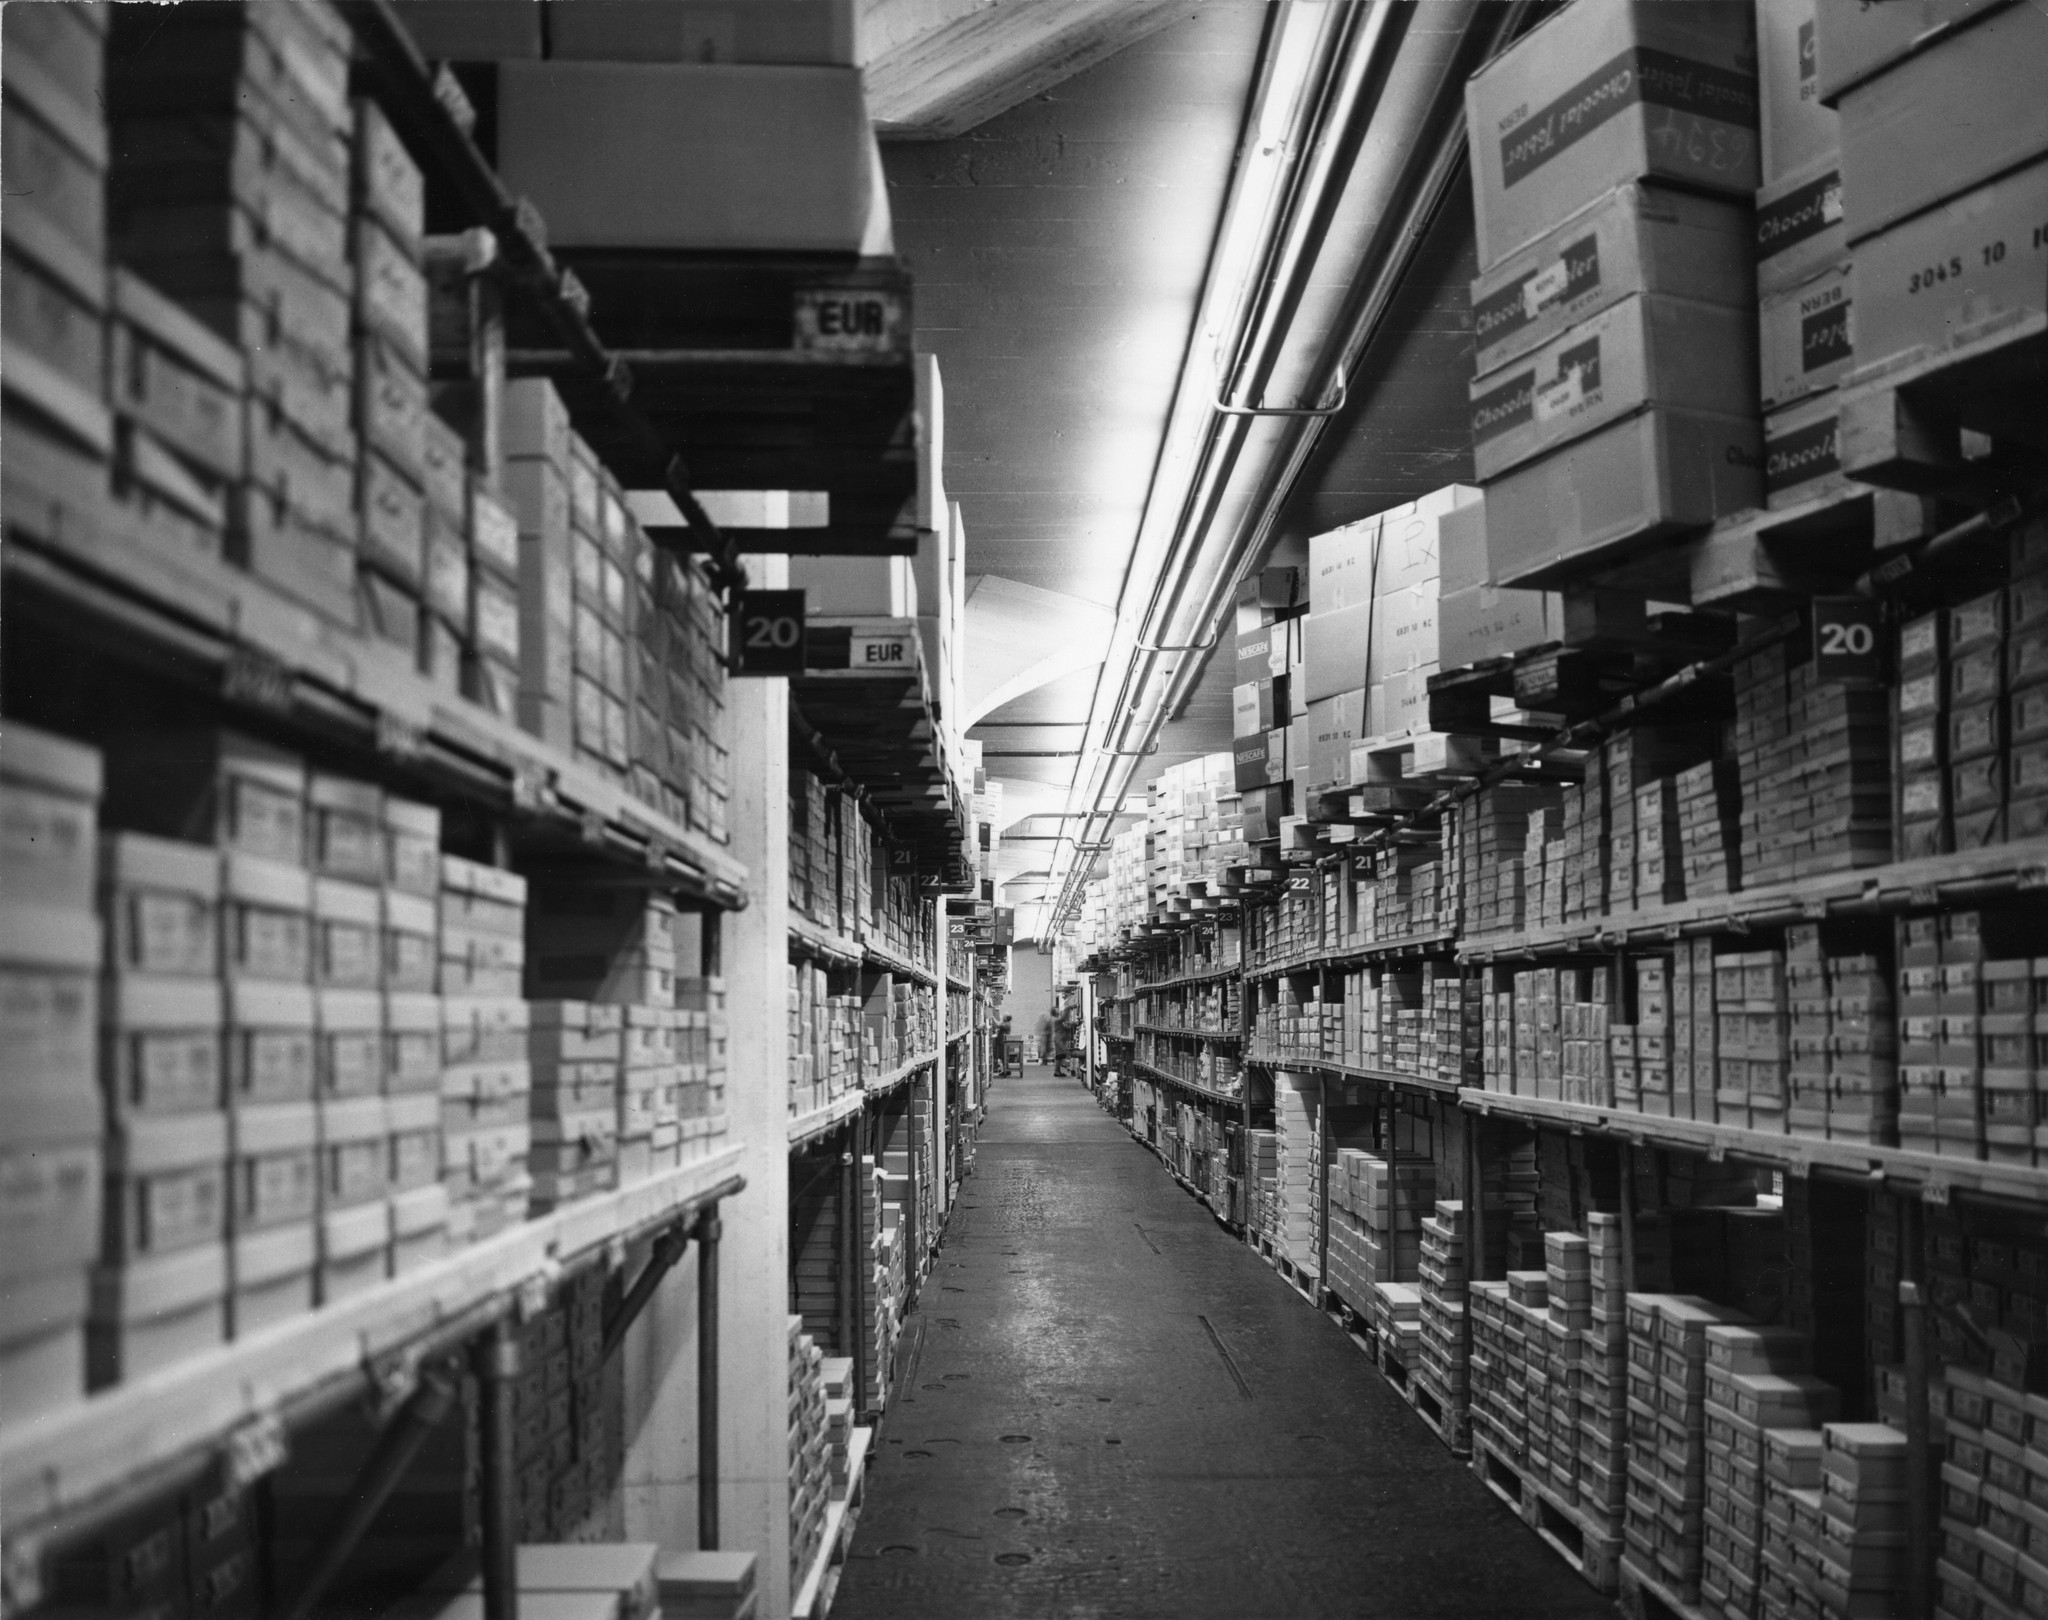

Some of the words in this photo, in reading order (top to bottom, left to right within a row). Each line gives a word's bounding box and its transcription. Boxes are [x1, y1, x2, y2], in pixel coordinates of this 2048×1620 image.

[1559, 69, 1632, 134] Chocolat
[1908, 256, 1962, 294] 3045
[1983, 240, 2006, 266] 10
[817, 300, 885, 337] EUR
[746, 616, 799, 649] 20
[1820, 622, 1874, 656] 20
[865, 644, 904, 663] EUR
[894, 850, 911, 864] 21
[1355, 855, 1372, 869] 21
[920, 874, 940, 887] 22
[1290, 877, 1310, 890] 22
[1219, 912, 1233, 922] 23
[950, 924, 965, 934] 23
[1201, 926, 1215, 935] 24
[963, 940, 975, 948] 24
